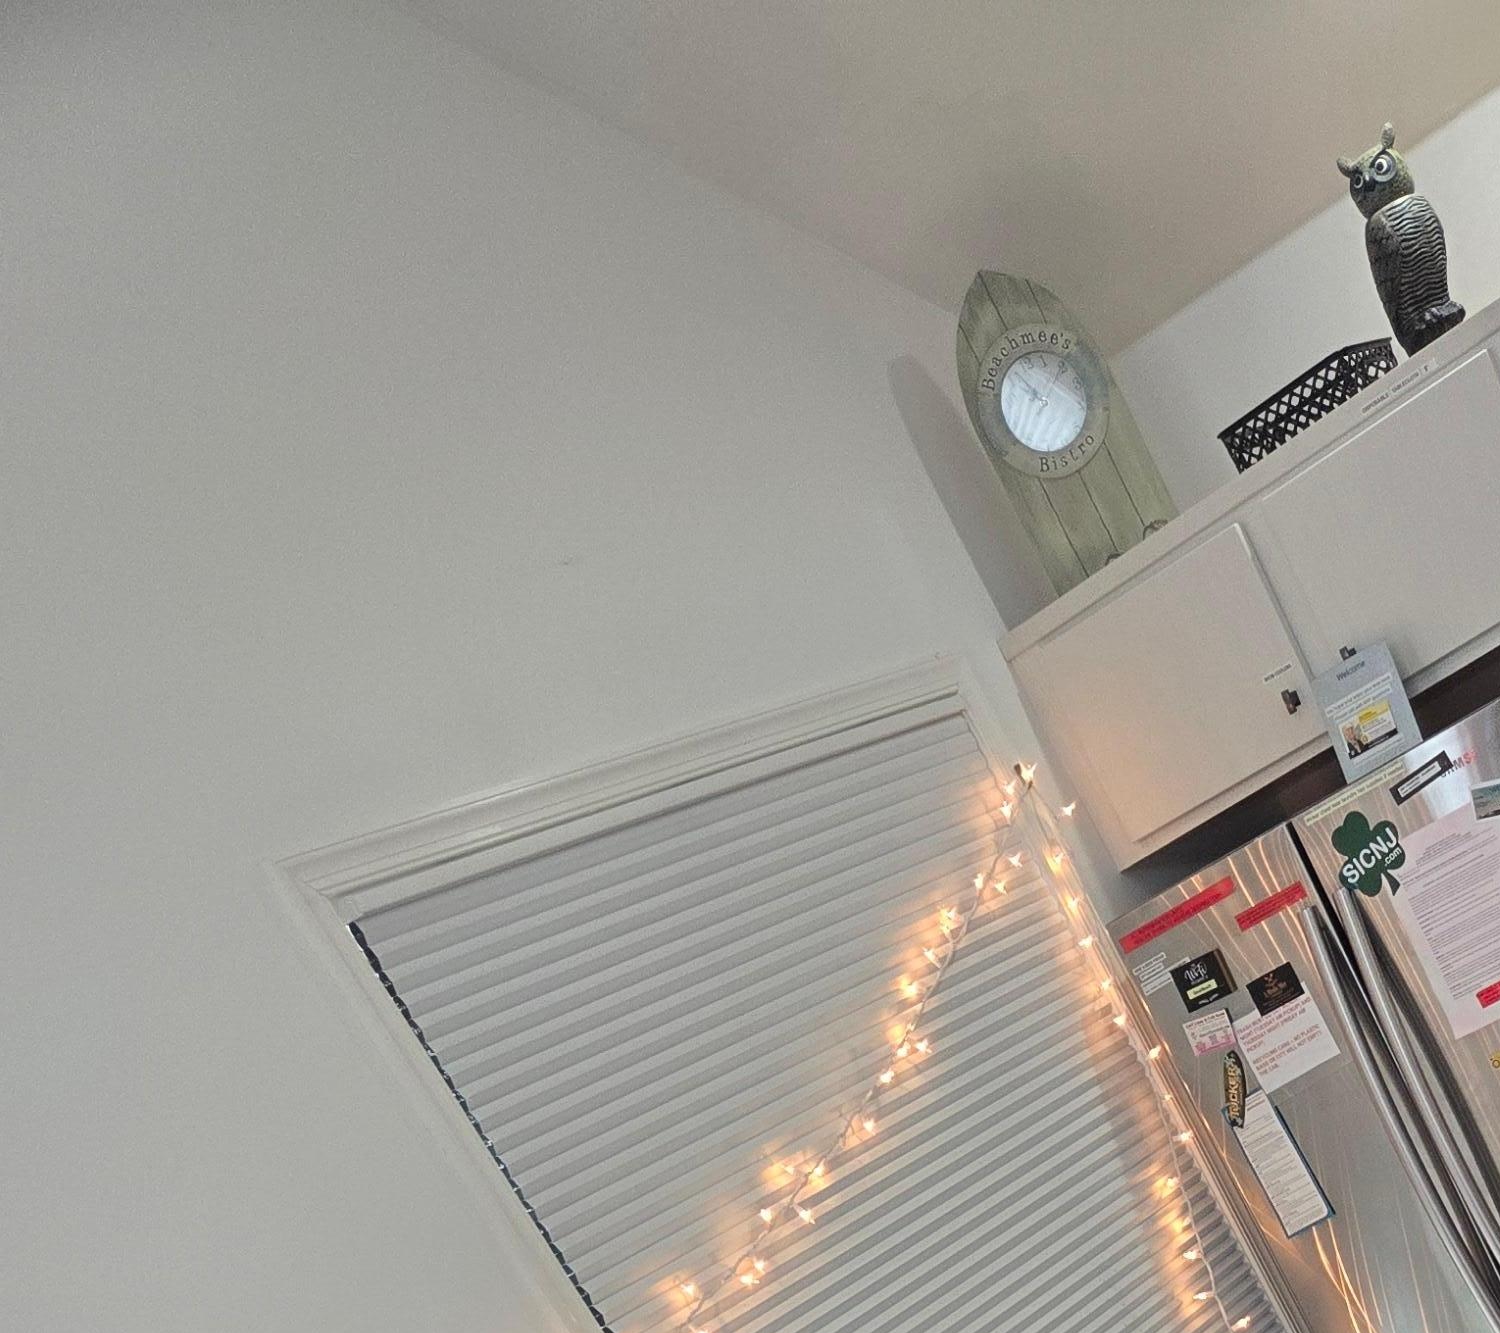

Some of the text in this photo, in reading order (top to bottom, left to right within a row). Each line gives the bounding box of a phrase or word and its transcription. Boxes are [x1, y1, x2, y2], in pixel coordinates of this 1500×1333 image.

[982, 330, 1070, 390] Beachmee's
[1039, 434, 1094, 472] Bistro
[1335, 659, 1367, 681] Welcome
[1341, 826, 1399, 886] SICNJ
[1382, 846, 1404, 868] .com
